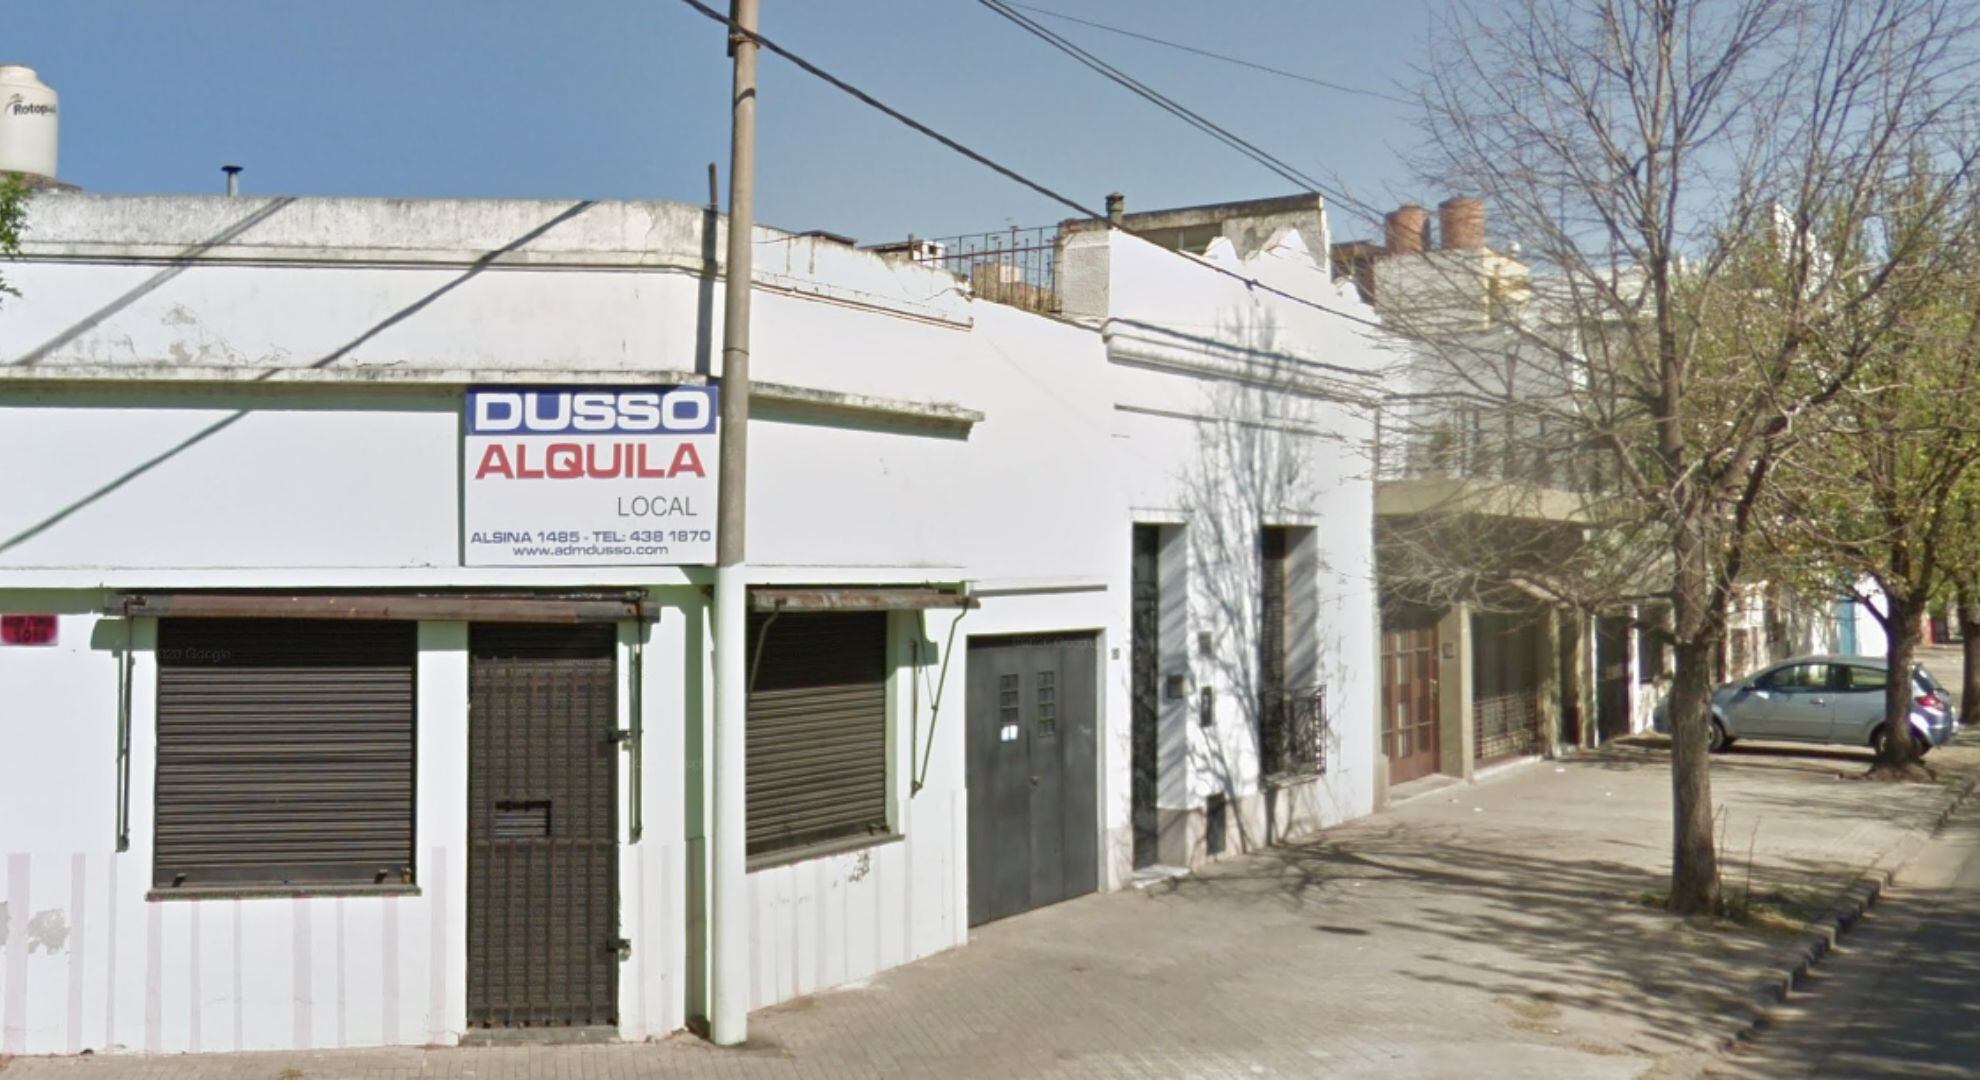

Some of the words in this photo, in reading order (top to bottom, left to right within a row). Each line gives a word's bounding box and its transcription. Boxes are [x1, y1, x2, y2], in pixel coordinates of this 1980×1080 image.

[474, 390, 710, 432] DUSSO
[474, 442, 706, 480] ALQUILA
[617, 495, 698, 517] LOCAL
[470, 531, 533, 545] ALSINA
[536, 530, 581, 544] 1485
[592, 530, 627, 544] TEL:
[629, 530, 664, 543] 438
[668, 530, 712, 543] 1870
[512, 545, 669, 557] www.admdusso.com
